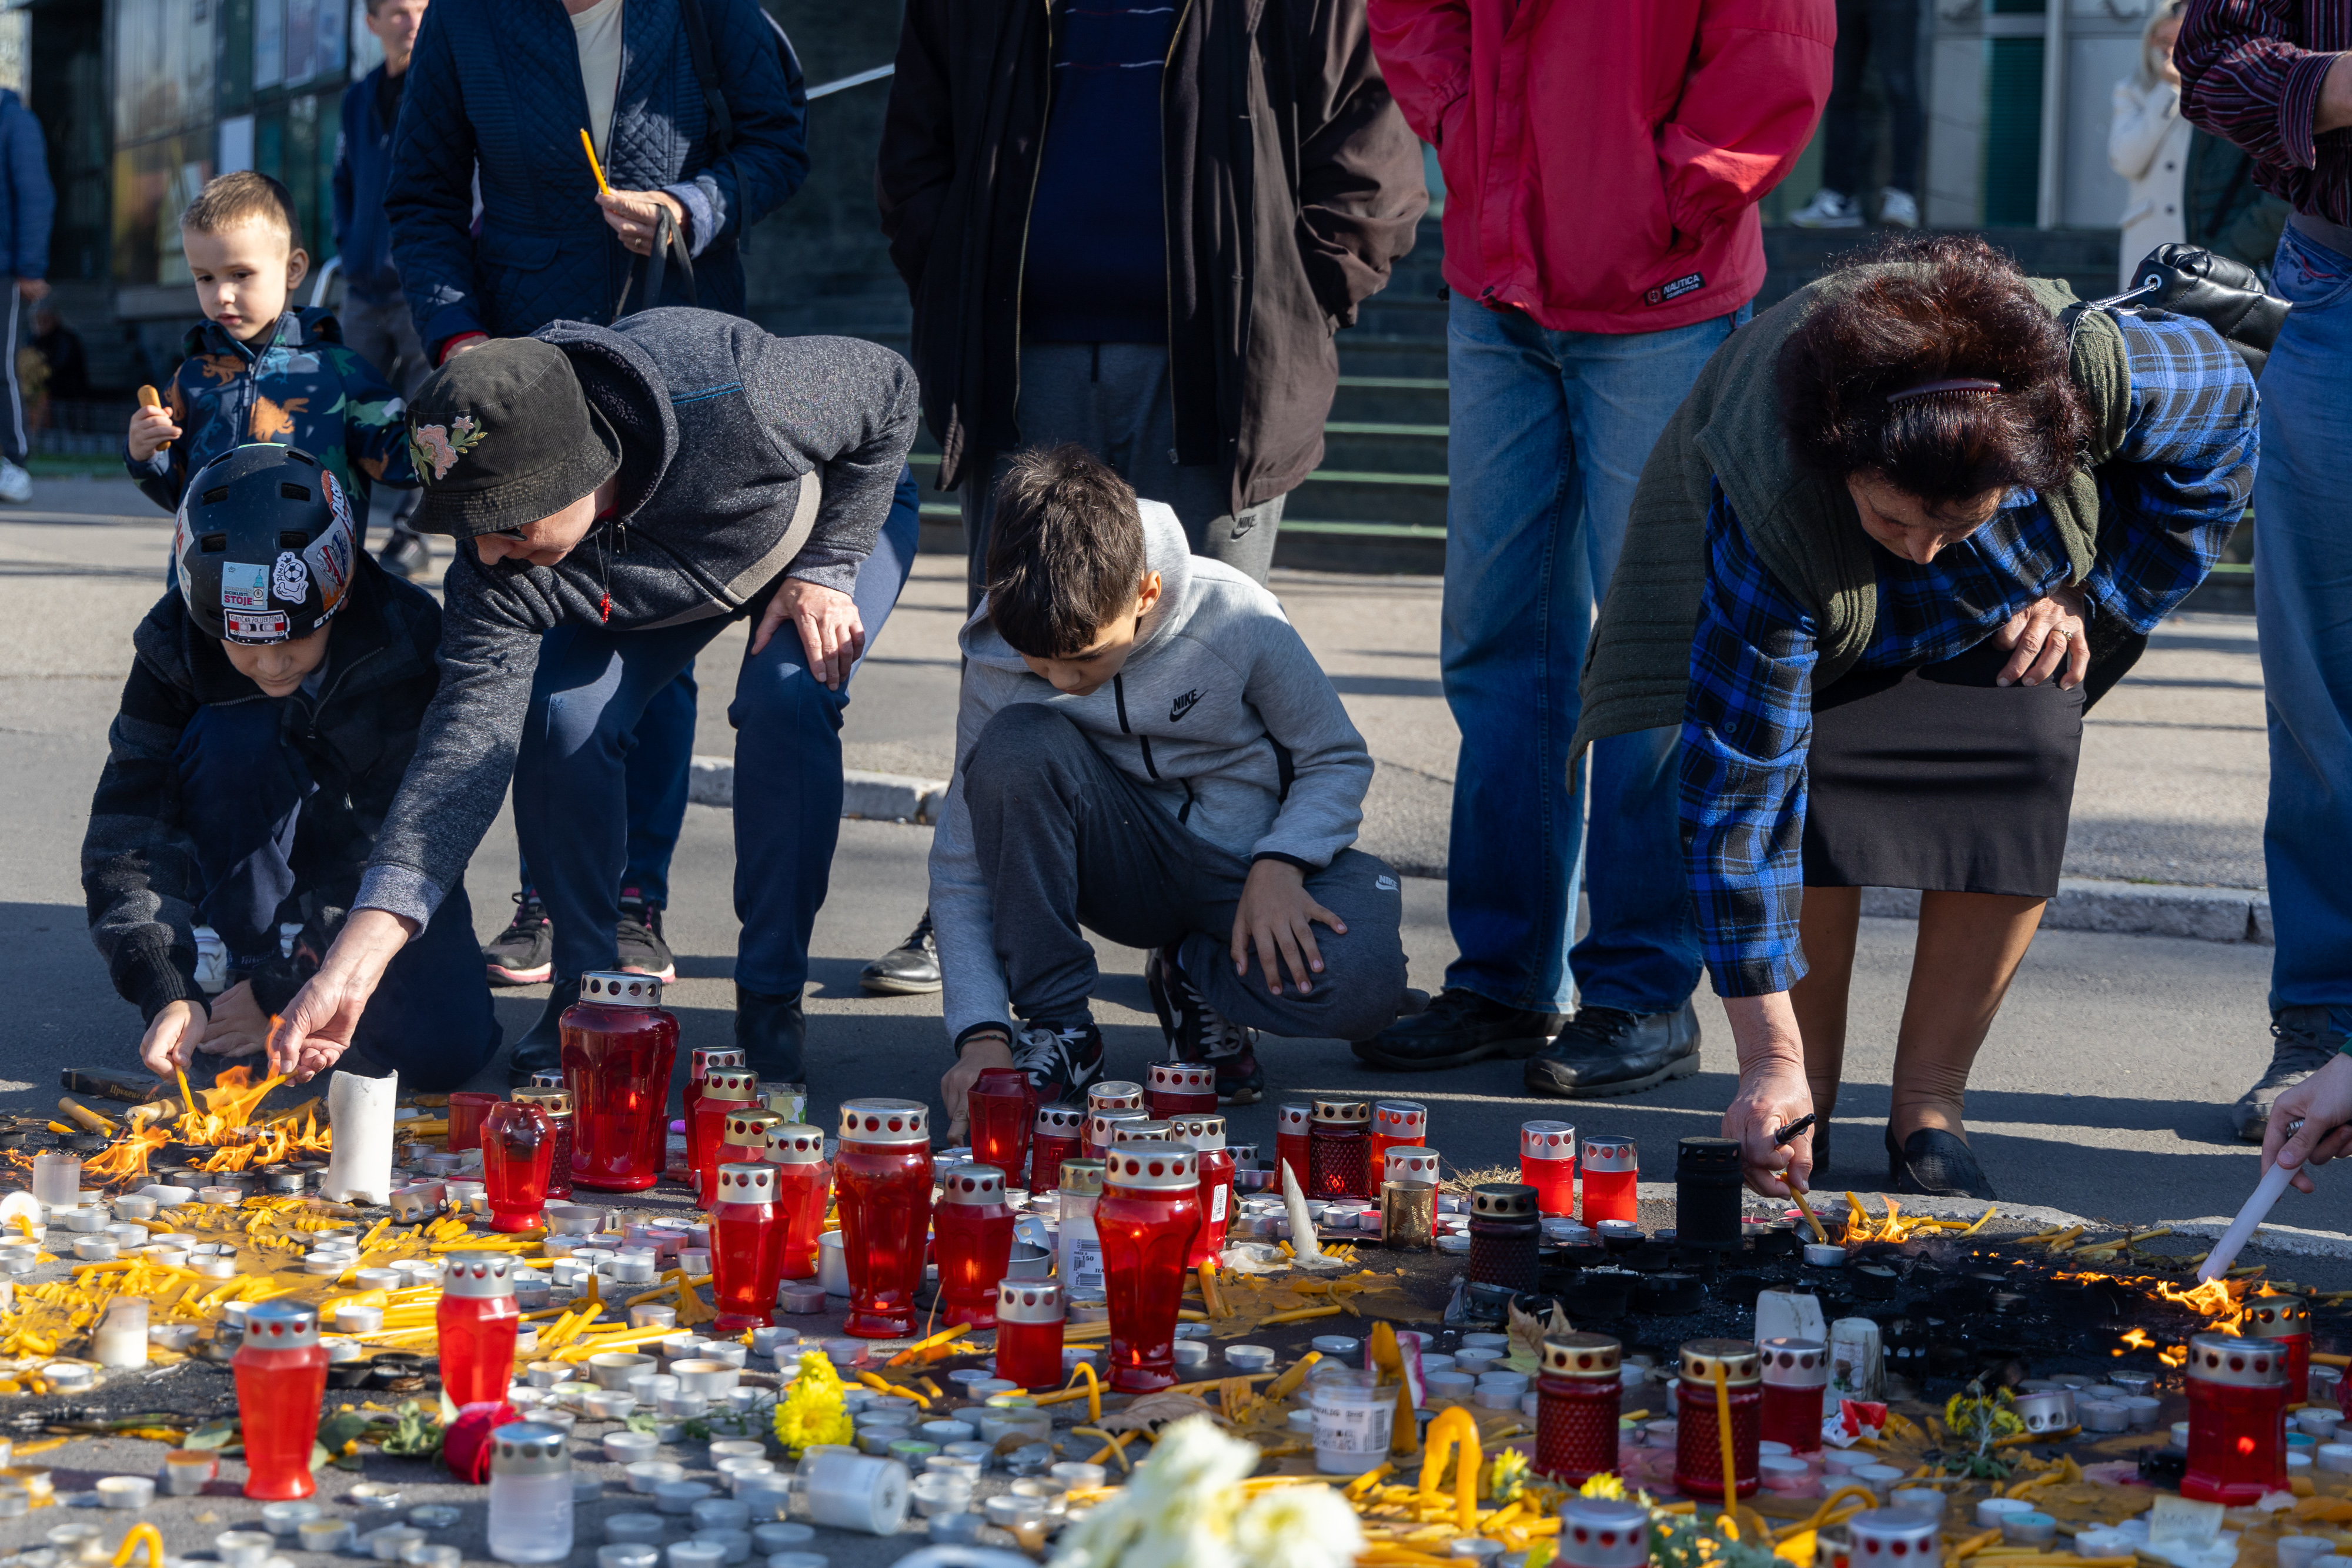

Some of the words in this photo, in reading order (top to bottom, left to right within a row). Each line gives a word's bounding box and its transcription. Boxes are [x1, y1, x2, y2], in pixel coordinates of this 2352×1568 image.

[1663, 275, 1700, 295] NAUTICA
[1666, 283, 1699, 299] COMPETITION
[1237, 514, 1258, 529] NIKE
[276, 563, 285, 581] PIMP
[224, 595, 253, 606] STOJE
[1173, 688, 1197, 712] NIKE
[1379, 875, 1397, 887] NIKE
